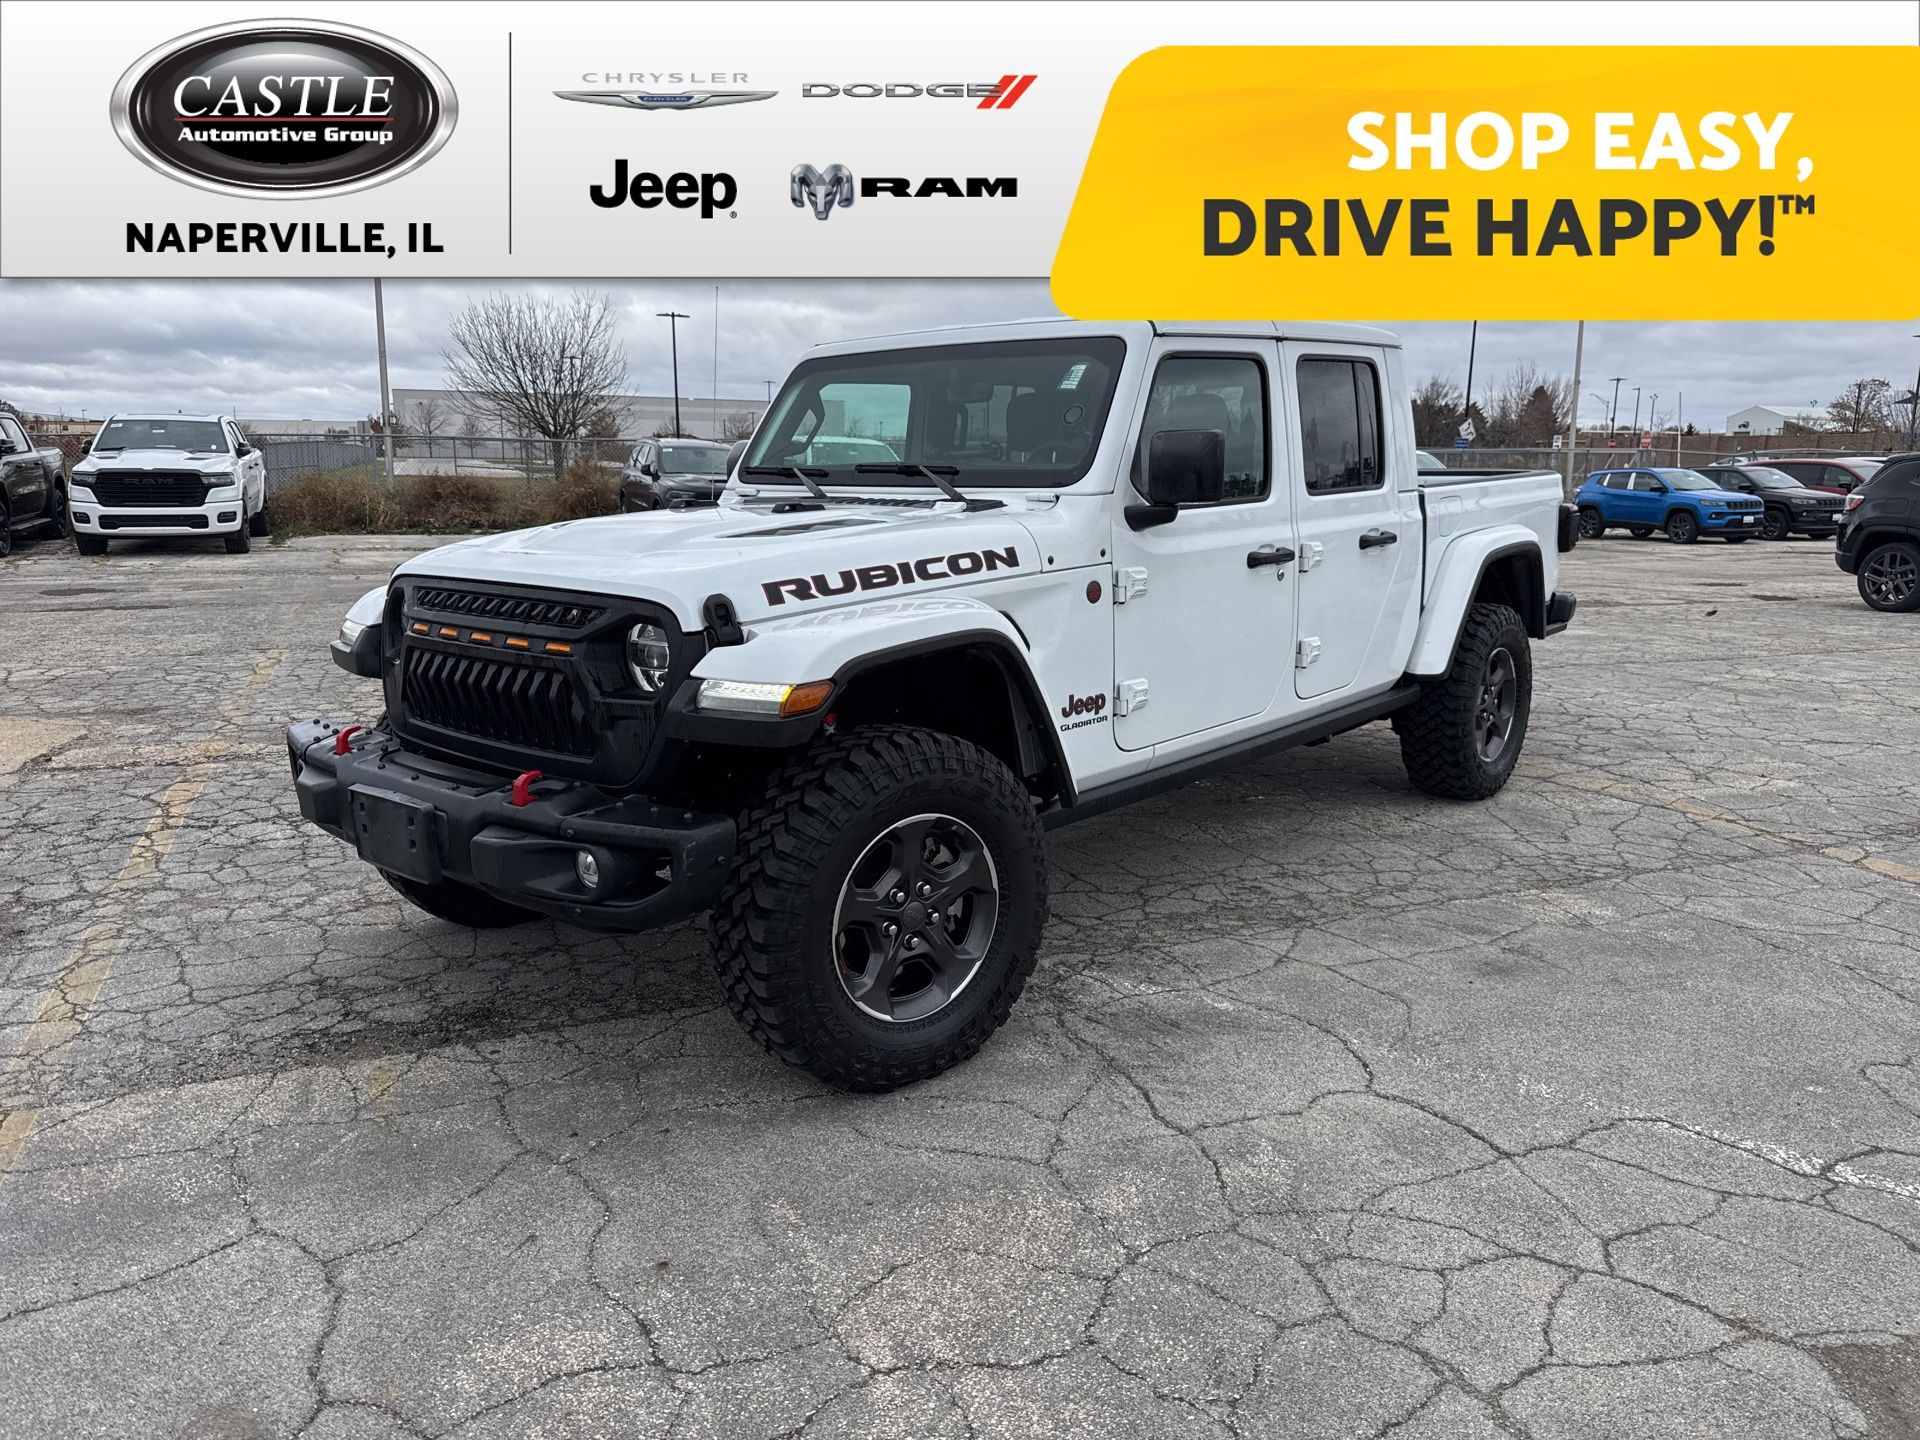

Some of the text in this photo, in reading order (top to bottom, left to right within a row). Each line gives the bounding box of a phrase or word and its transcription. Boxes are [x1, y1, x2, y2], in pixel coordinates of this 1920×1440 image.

[123, 478, 175, 486] RAM
[760, 546, 1021, 607] RUBICON
[1061, 692, 1106, 718] Jeep
[1060, 715, 1108, 732] GLADIATOR
